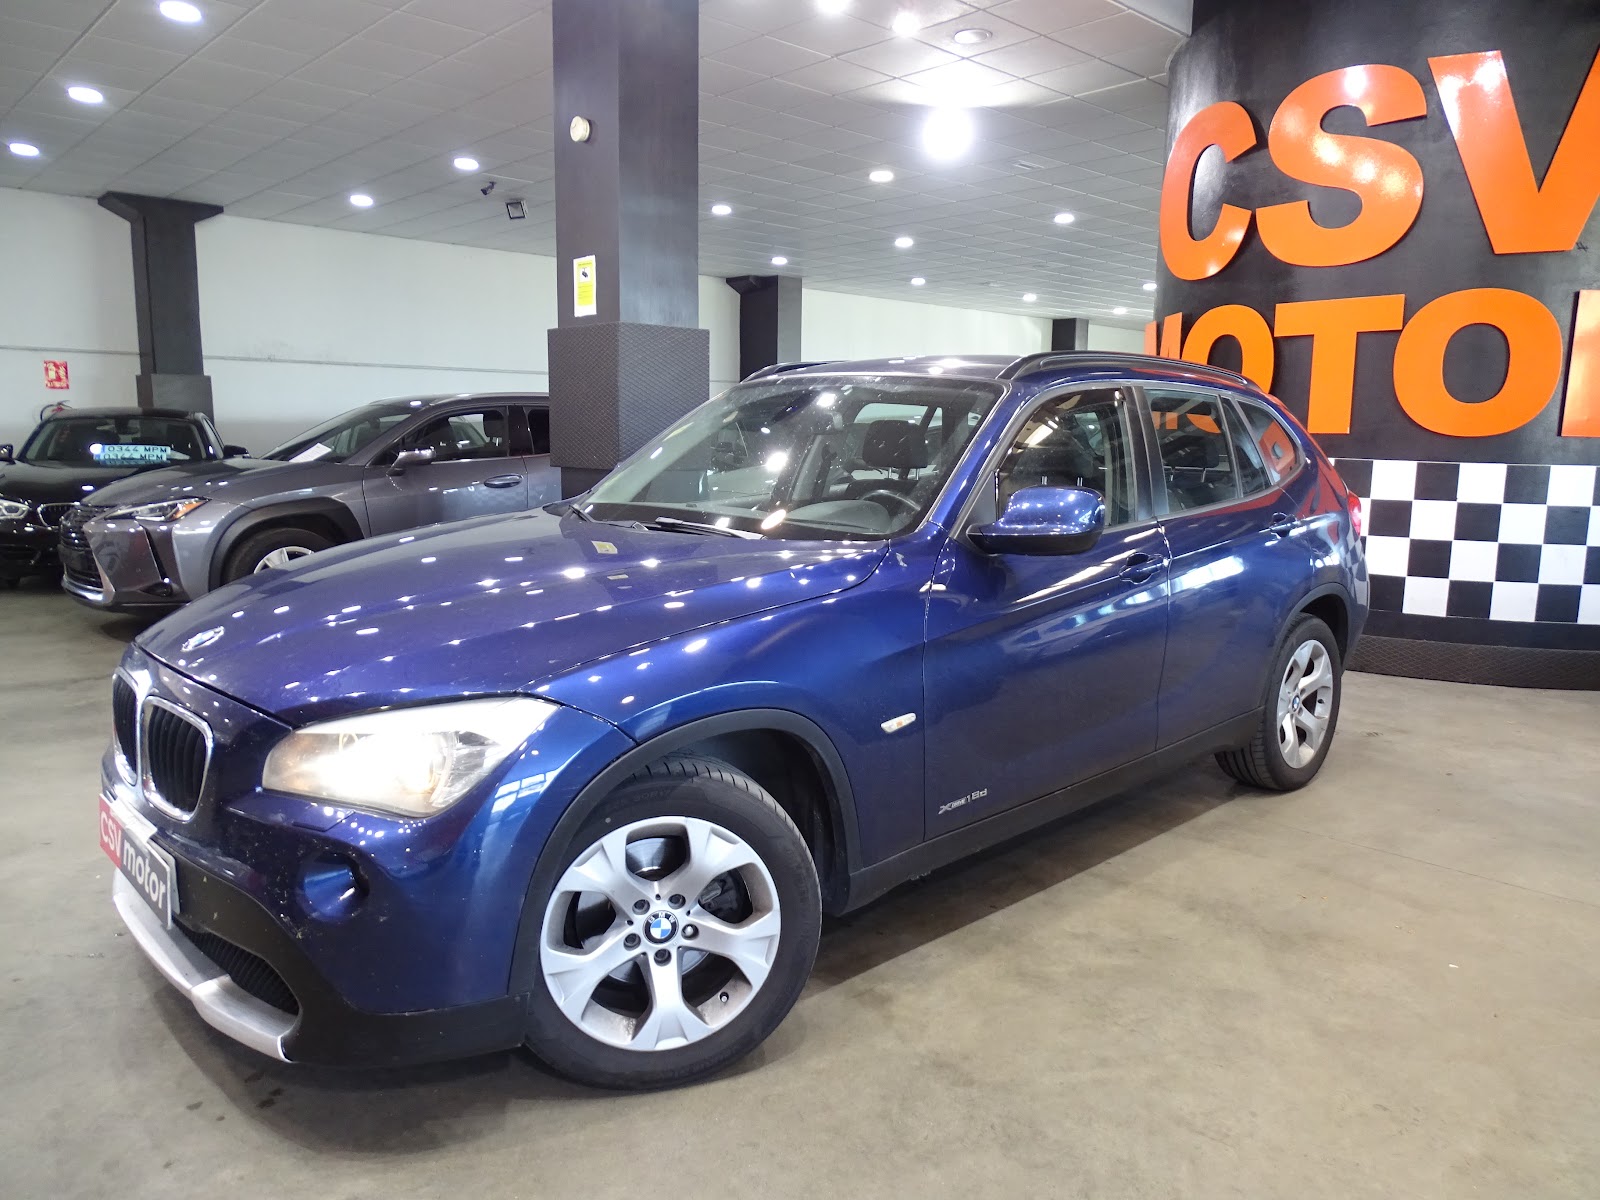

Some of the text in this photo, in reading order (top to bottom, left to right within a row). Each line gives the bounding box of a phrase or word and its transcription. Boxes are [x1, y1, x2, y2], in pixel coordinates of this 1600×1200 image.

[1159, 50, 1600, 281] CSV
[1143, 287, 1600, 437] MOTO
[107, 445, 168, 454] 0344 MPM
[100, 811, 166, 908] CSV motor
[647, 912, 676, 924] BMW
